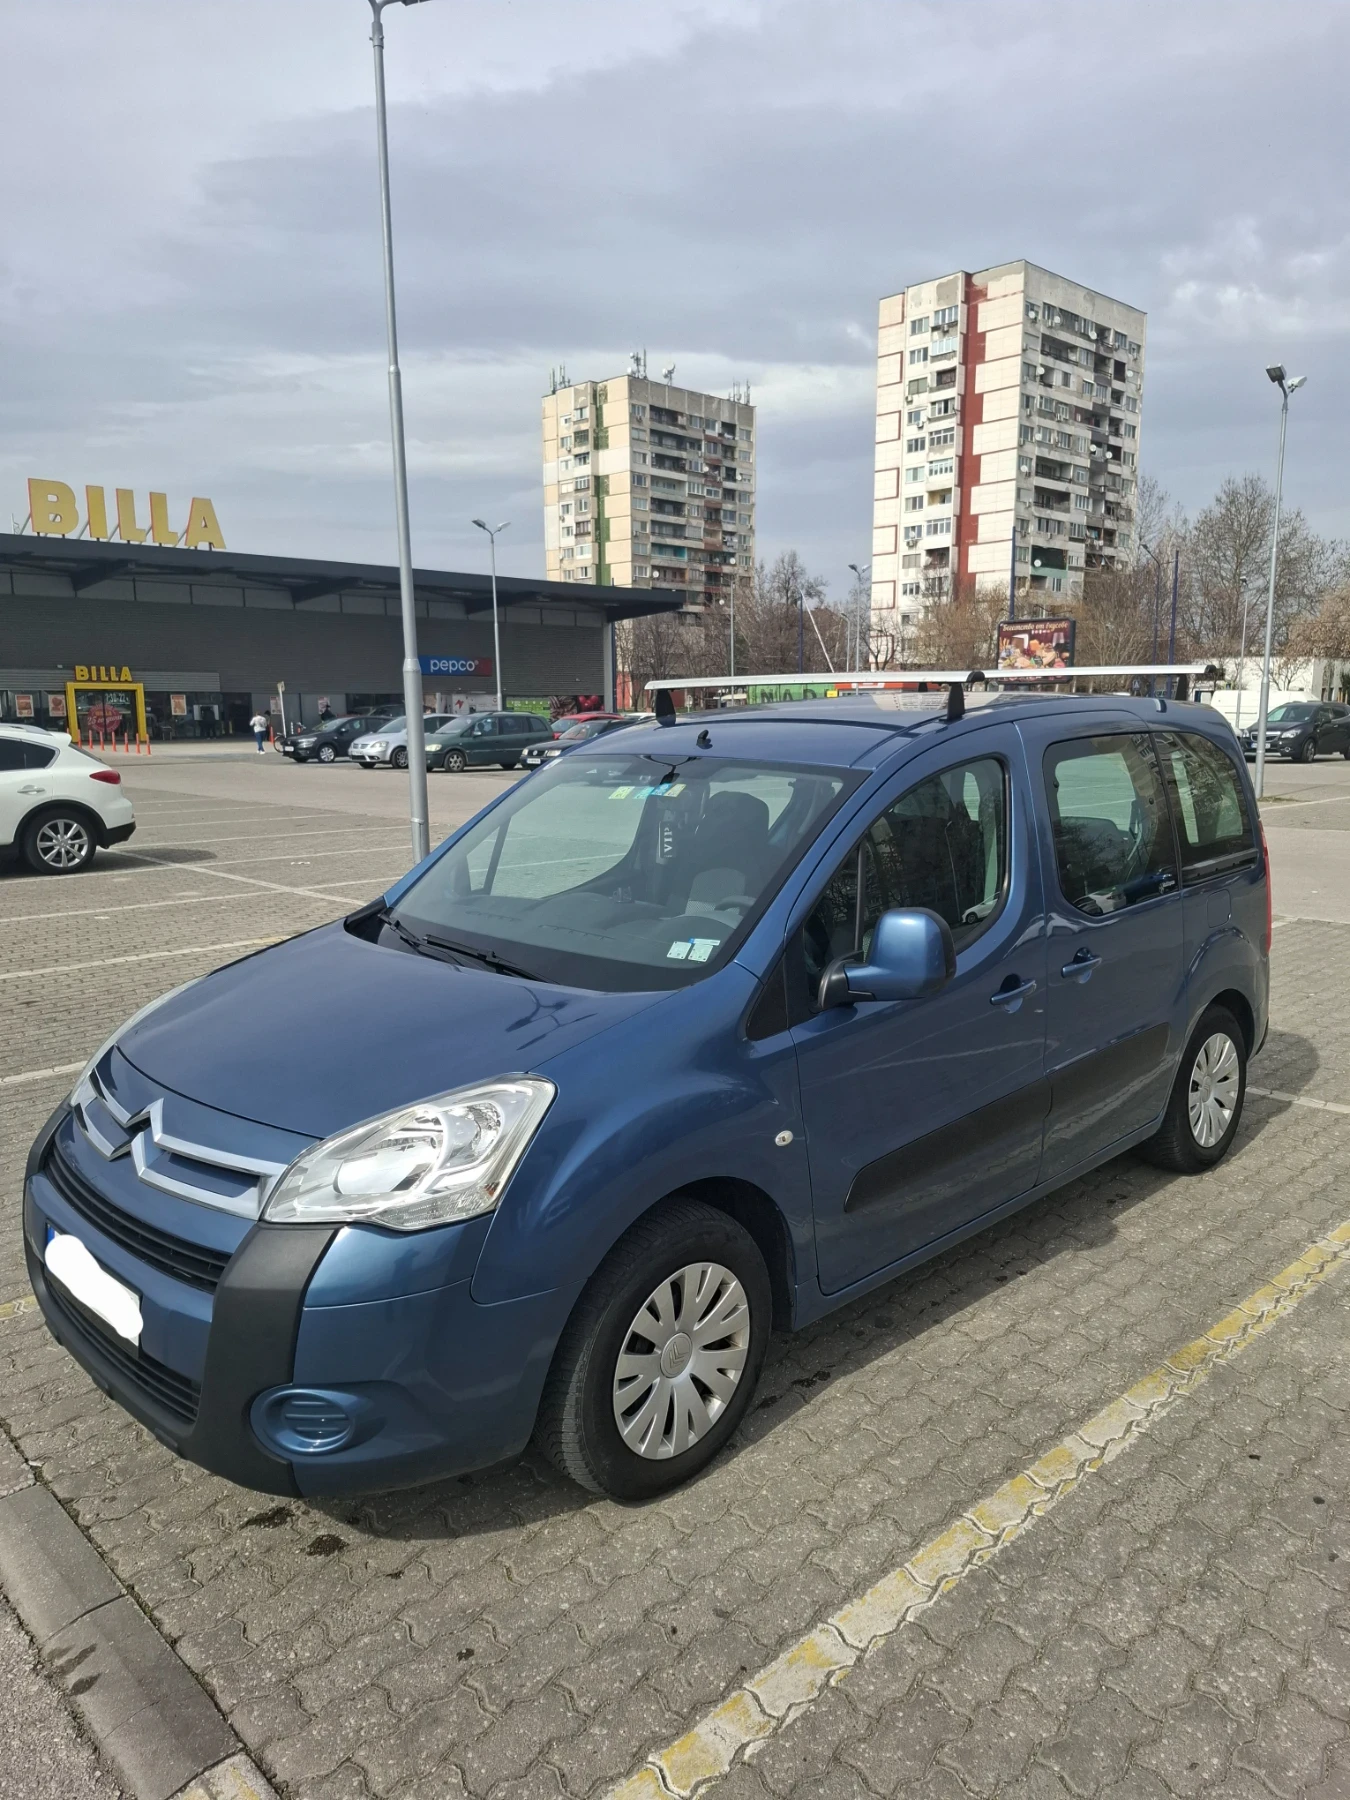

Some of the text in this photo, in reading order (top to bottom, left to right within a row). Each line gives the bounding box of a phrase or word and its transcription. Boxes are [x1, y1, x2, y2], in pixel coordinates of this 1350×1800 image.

[27, 478, 227, 549] BILLA
[75, 665, 133, 682] BILLA
[664, 827, 673, 852] VIP
